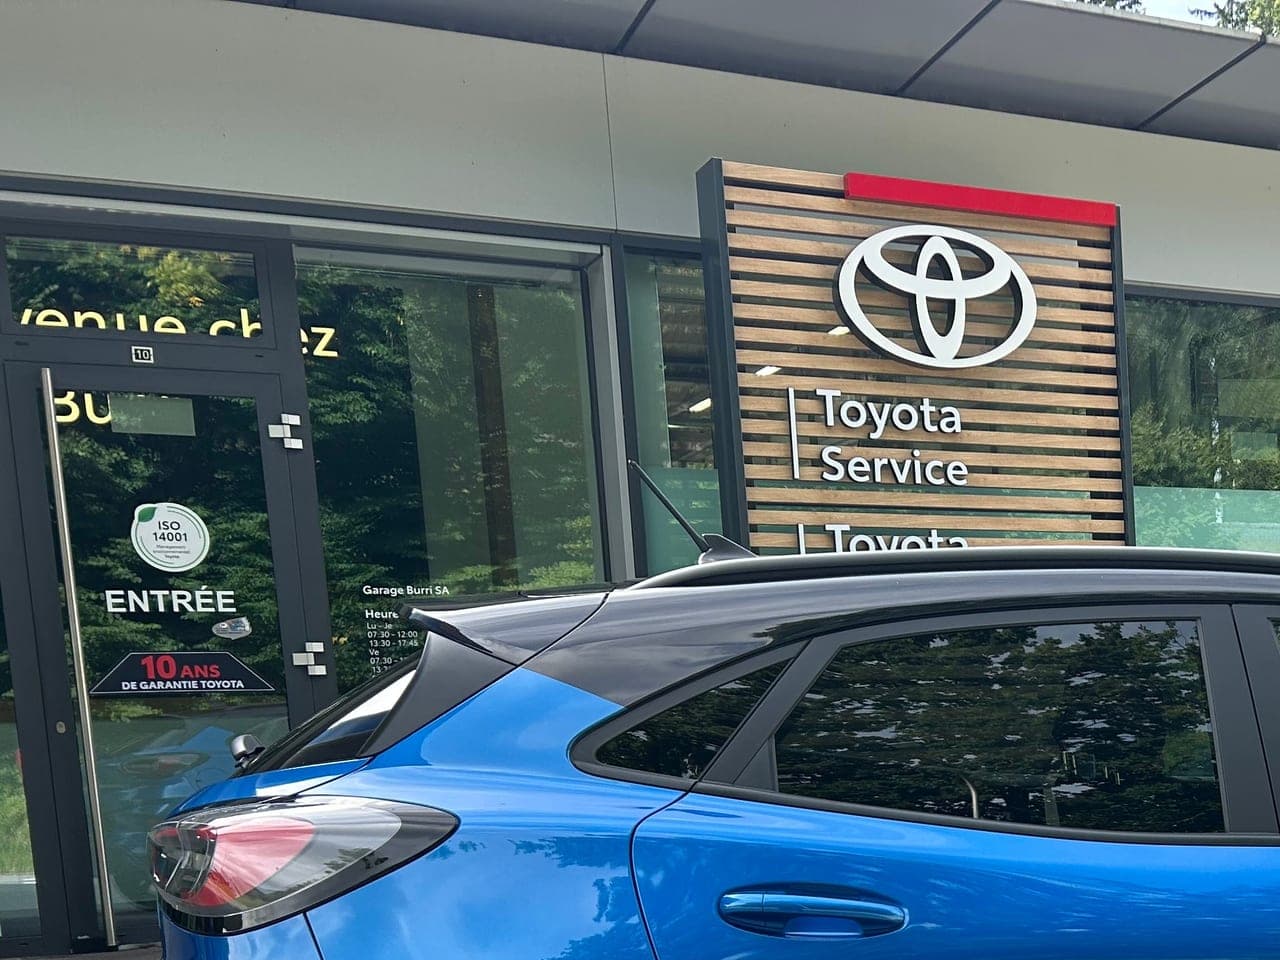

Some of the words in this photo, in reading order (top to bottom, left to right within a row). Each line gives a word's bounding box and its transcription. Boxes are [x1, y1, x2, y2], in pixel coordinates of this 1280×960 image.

[136, 350, 149, 360] 10
[815, 388, 963, 440] Toyota
[820, 446, 969, 486] Service
[158, 521, 181, 531] ISO
[152, 532, 188, 542] 14001
[362, 585, 404, 597] Garage
[406, 585, 433, 595] Burri
[434, 586, 450, 595] SA
[105, 585, 237, 613] ENTRÉE
[141, 655, 177, 680] 10
[180, 665, 221, 679] ANS
[121, 681, 138, 690] DE
[139, 680, 199, 690] GARANTIE
[199, 680, 245, 689] TOYOTA
